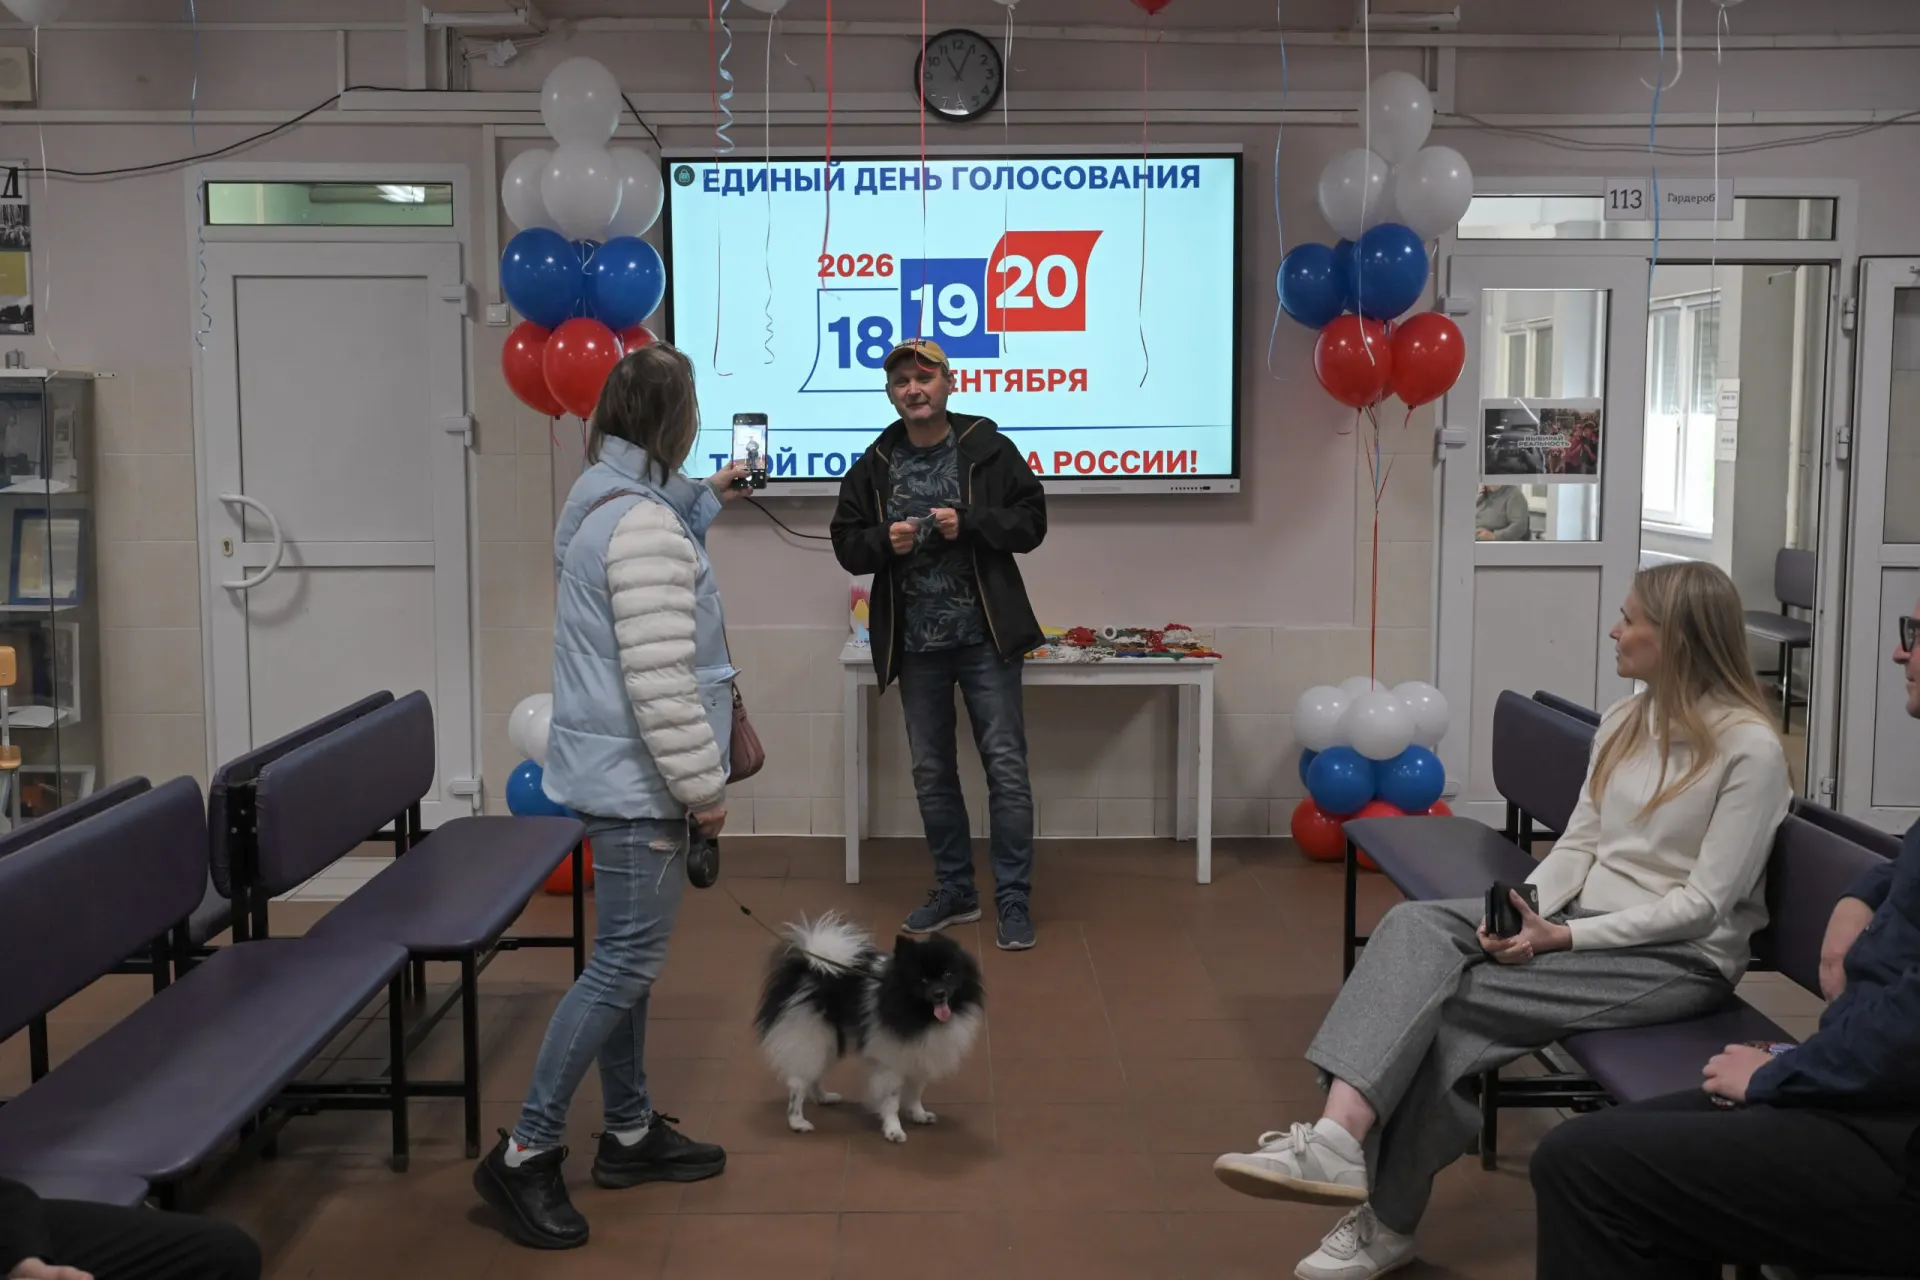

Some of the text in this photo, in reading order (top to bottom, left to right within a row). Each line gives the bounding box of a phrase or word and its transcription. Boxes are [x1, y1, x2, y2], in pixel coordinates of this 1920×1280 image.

[939, 45, 948, 56] 11
[952, 39, 964, 50] 12
[928, 56, 940, 67] 10
[980, 54, 988, 65] 2
[986, 68, 994, 80] 3
[981, 84, 991, 95] 4
[972, 96, 980, 107] 5
[703, 161, 1200, 196] ЕДИНЫЙ ДЕНЬ ГОЛОСОВАНИЯ
[1610, 189, 1642, 209] 113
[1667, 193, 1715, 204] Гардероб
[817, 253, 894, 277] 2026
[995, 254, 1079, 309] 20
[911, 283, 978, 337] 19
[828, 315, 893, 369] 18
[951, 368, 1087, 392] НТЯБРЯ
[709, 446, 796, 476] ТЙ
[1026, 451, 1044, 474] А
[1053, 449, 1197, 475] РОССИИ!
